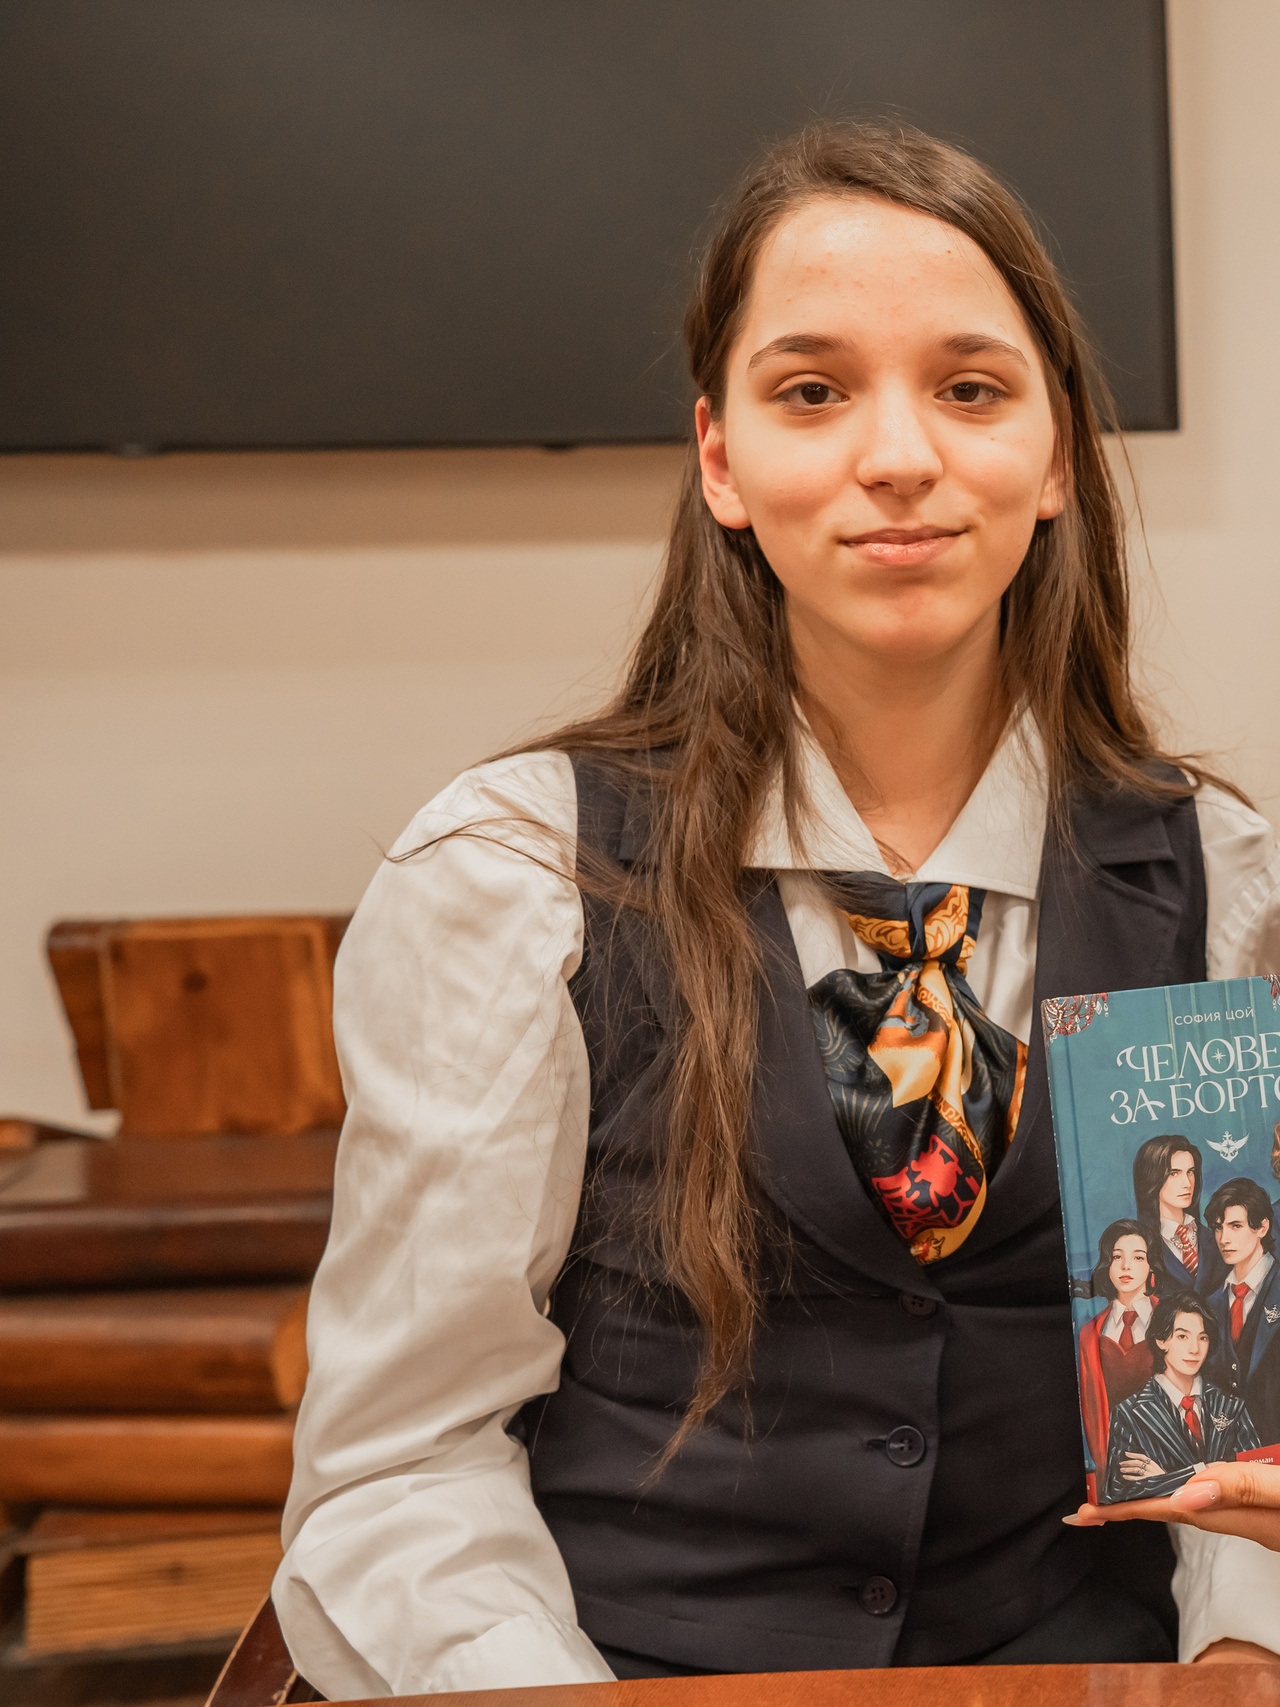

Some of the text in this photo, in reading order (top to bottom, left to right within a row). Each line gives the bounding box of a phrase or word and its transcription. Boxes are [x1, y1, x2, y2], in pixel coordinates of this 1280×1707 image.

[1174, 1006, 1255, 1026] СОФИЯ ЦОЙ
[1109, 1088, 1166, 1125] ЗА
